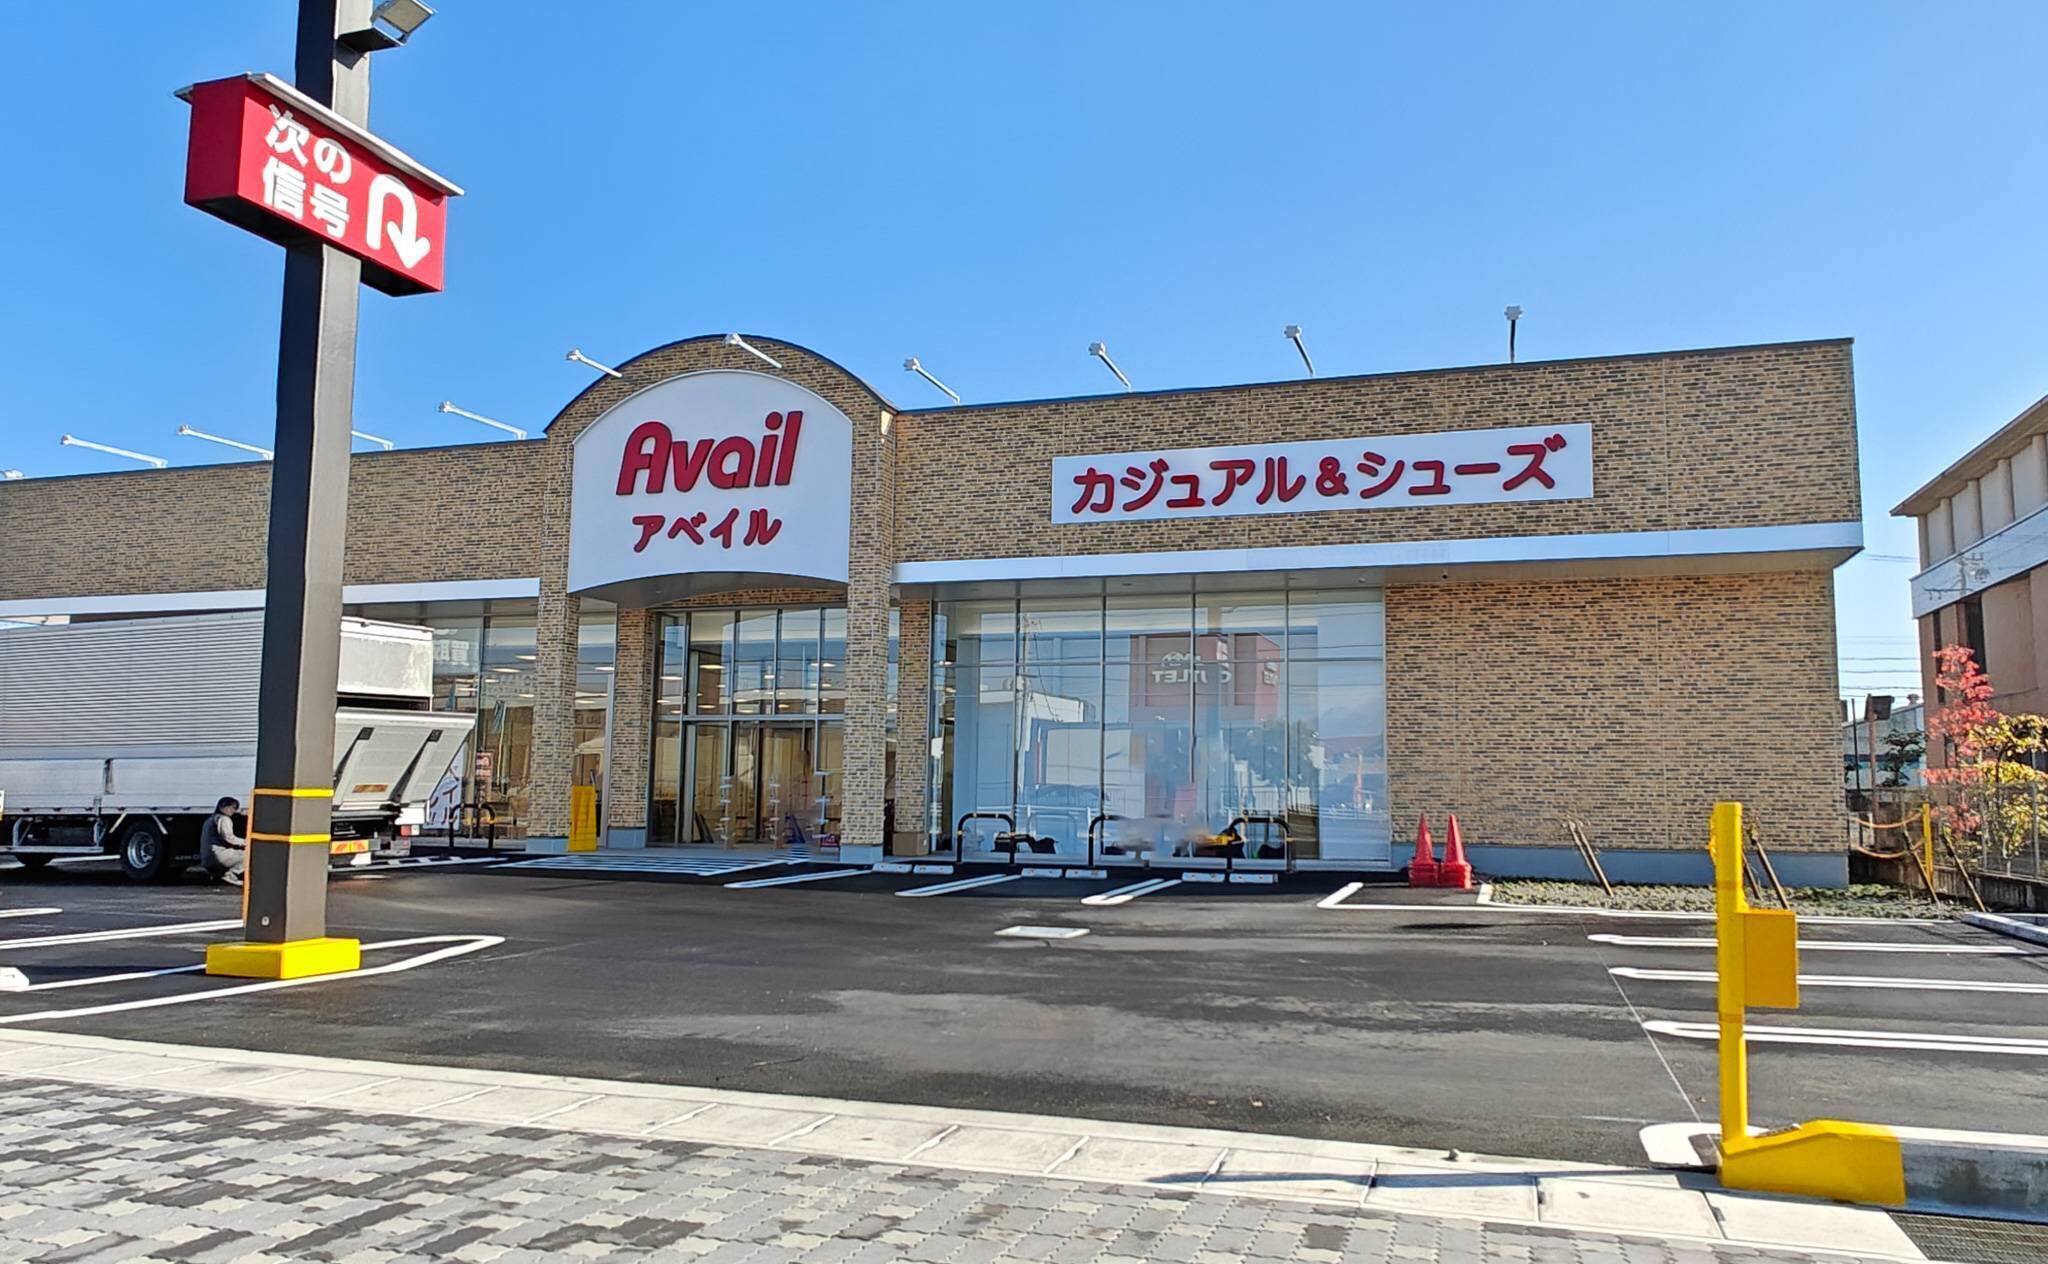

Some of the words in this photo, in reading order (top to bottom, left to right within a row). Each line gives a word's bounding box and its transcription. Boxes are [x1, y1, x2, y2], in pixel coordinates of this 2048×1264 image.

[265, 104, 352, 184] 次の
[263, 157, 350, 239] 信号
[615, 410, 804, 496] Avail
[1071, 433, 1568, 514] カジュアル&シューズ
[632, 508, 782, 553] アベイル
